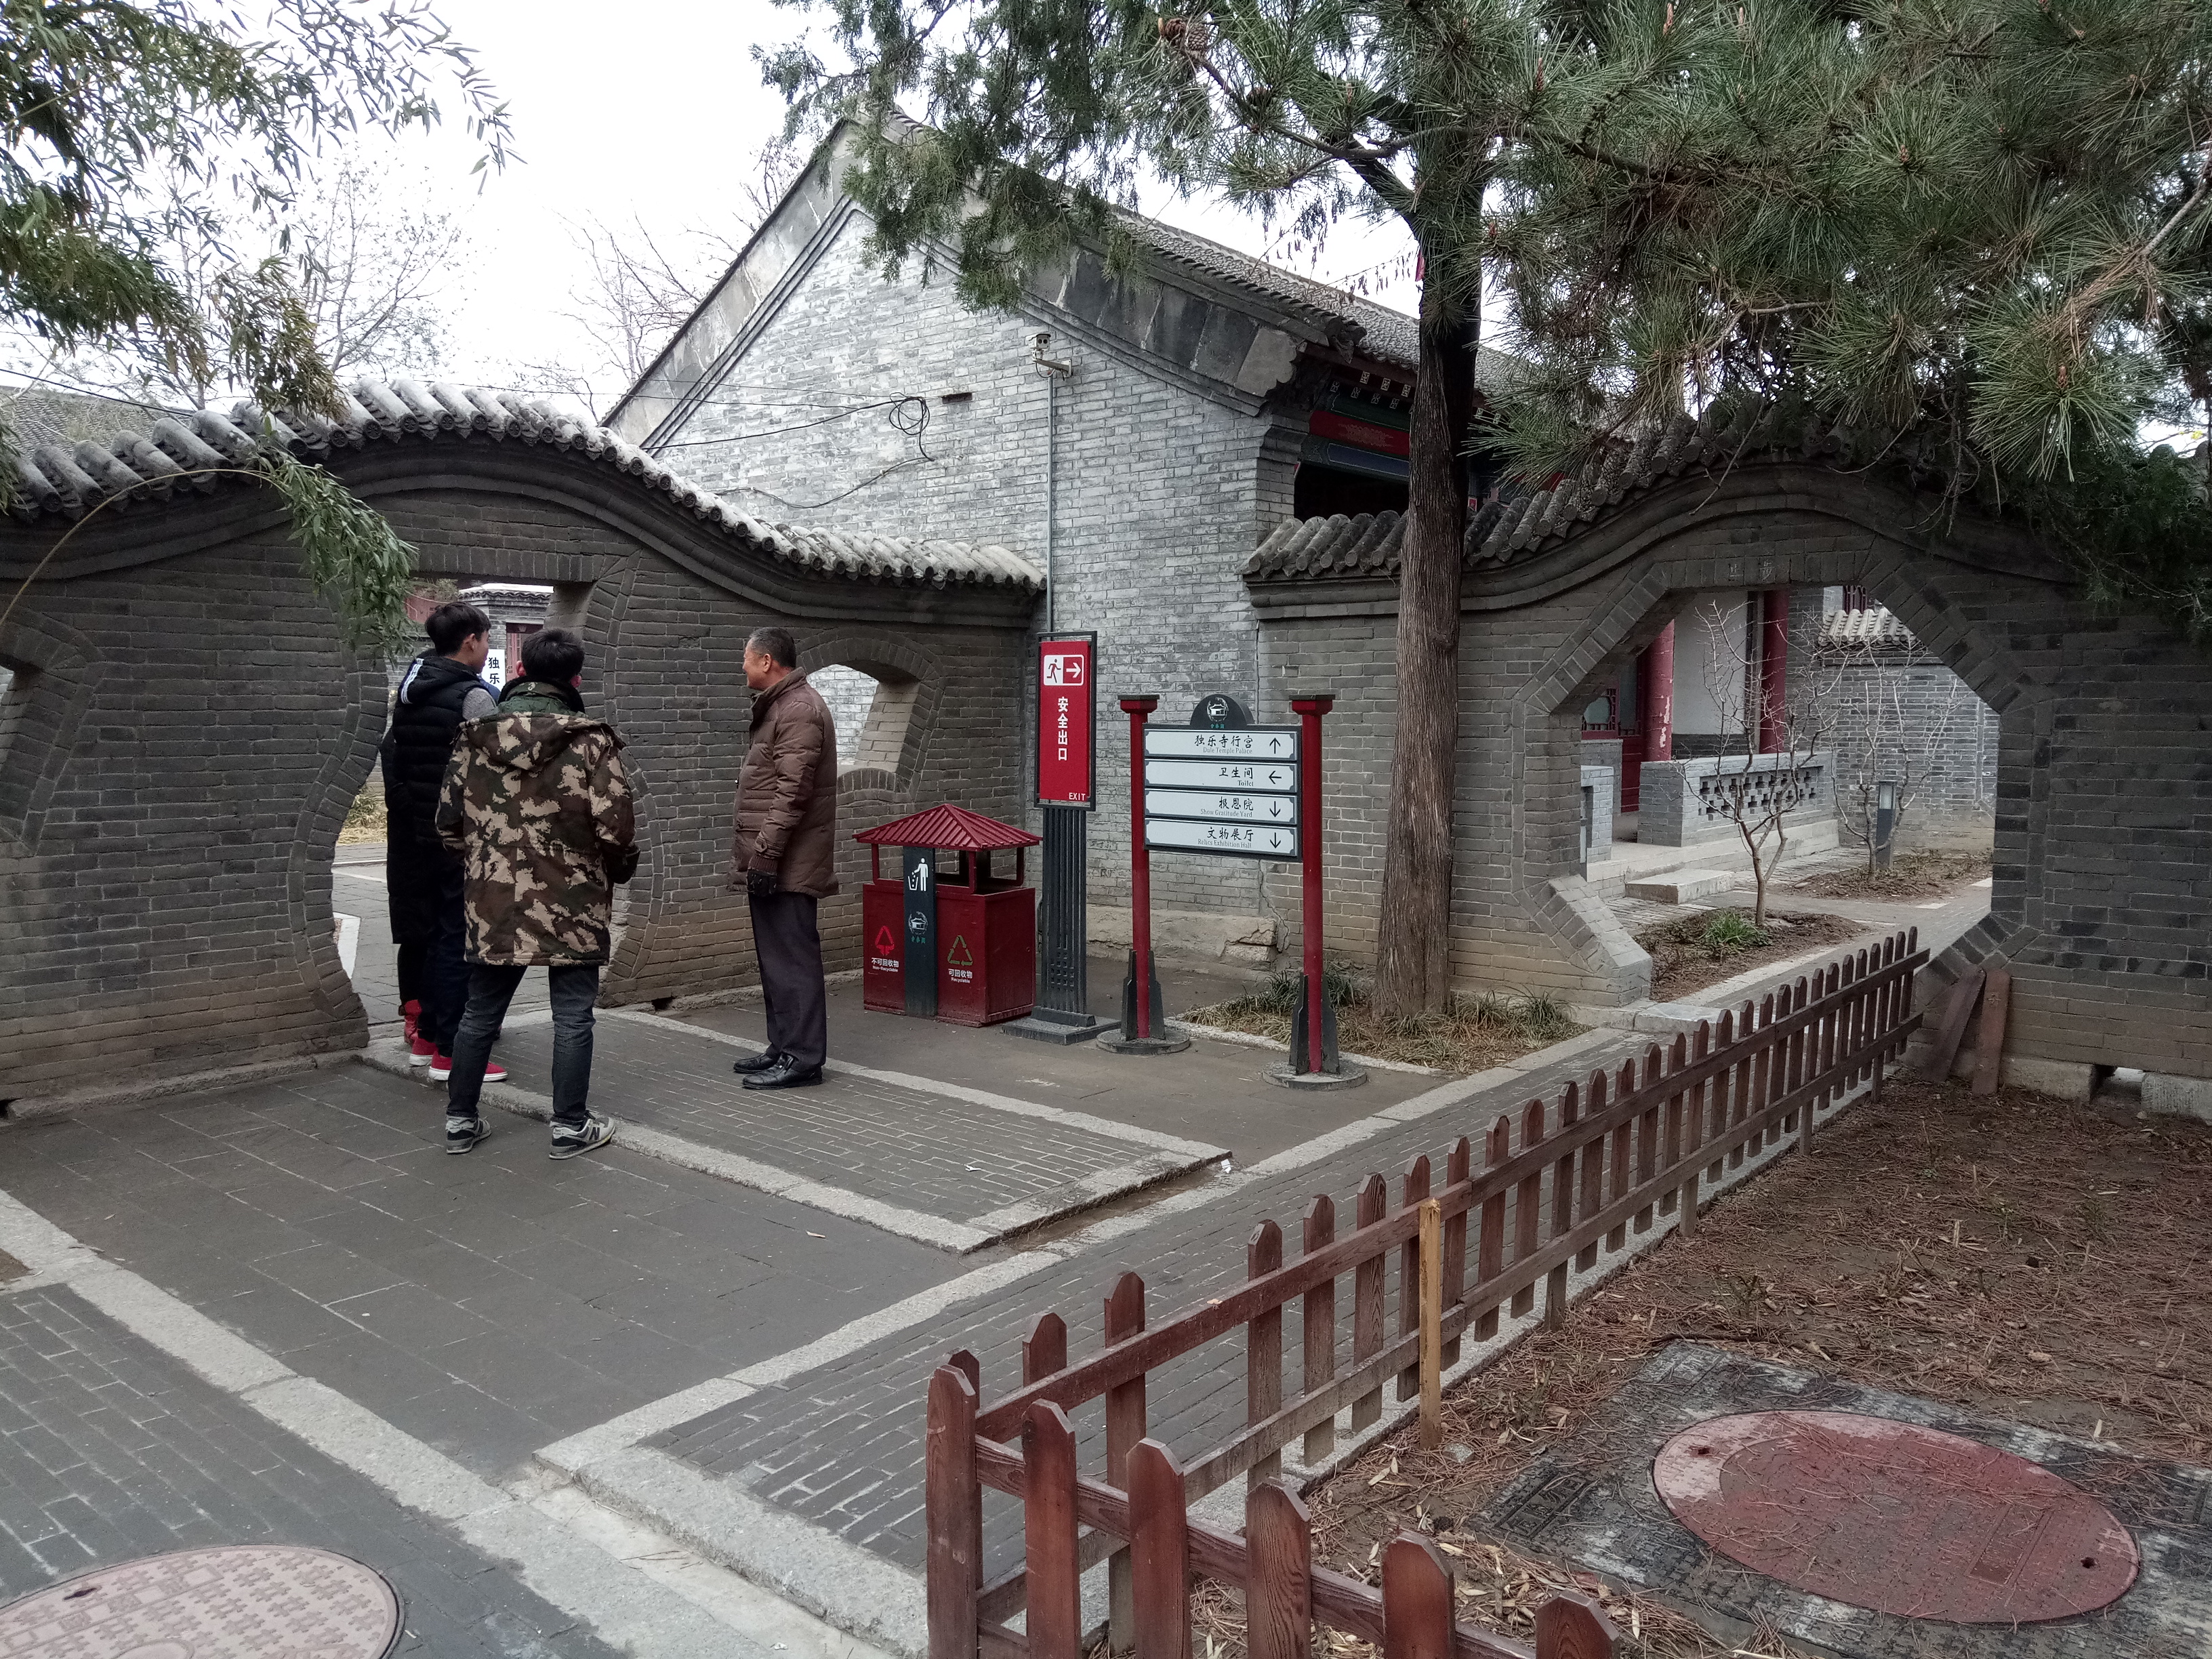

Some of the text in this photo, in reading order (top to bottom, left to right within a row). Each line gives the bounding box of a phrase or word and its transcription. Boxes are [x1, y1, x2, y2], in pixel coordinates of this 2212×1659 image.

[488, 657, 500, 684] 独乐
[1057, 696, 1069, 761] 安全出口
[1194, 734, 1253, 748] 独乐寺行宫
[1218, 766, 1253, 779] 卫生间
[1069, 792, 1086, 801] EXIT
[1218, 796, 1254, 811] 报恩院
[1207, 827, 1254, 842] 文物展厅
[1214, 840, 1240, 848] Exhibition
[871, 957, 899, 968] 不可回收物
[948, 968, 973, 979] 可回收物
